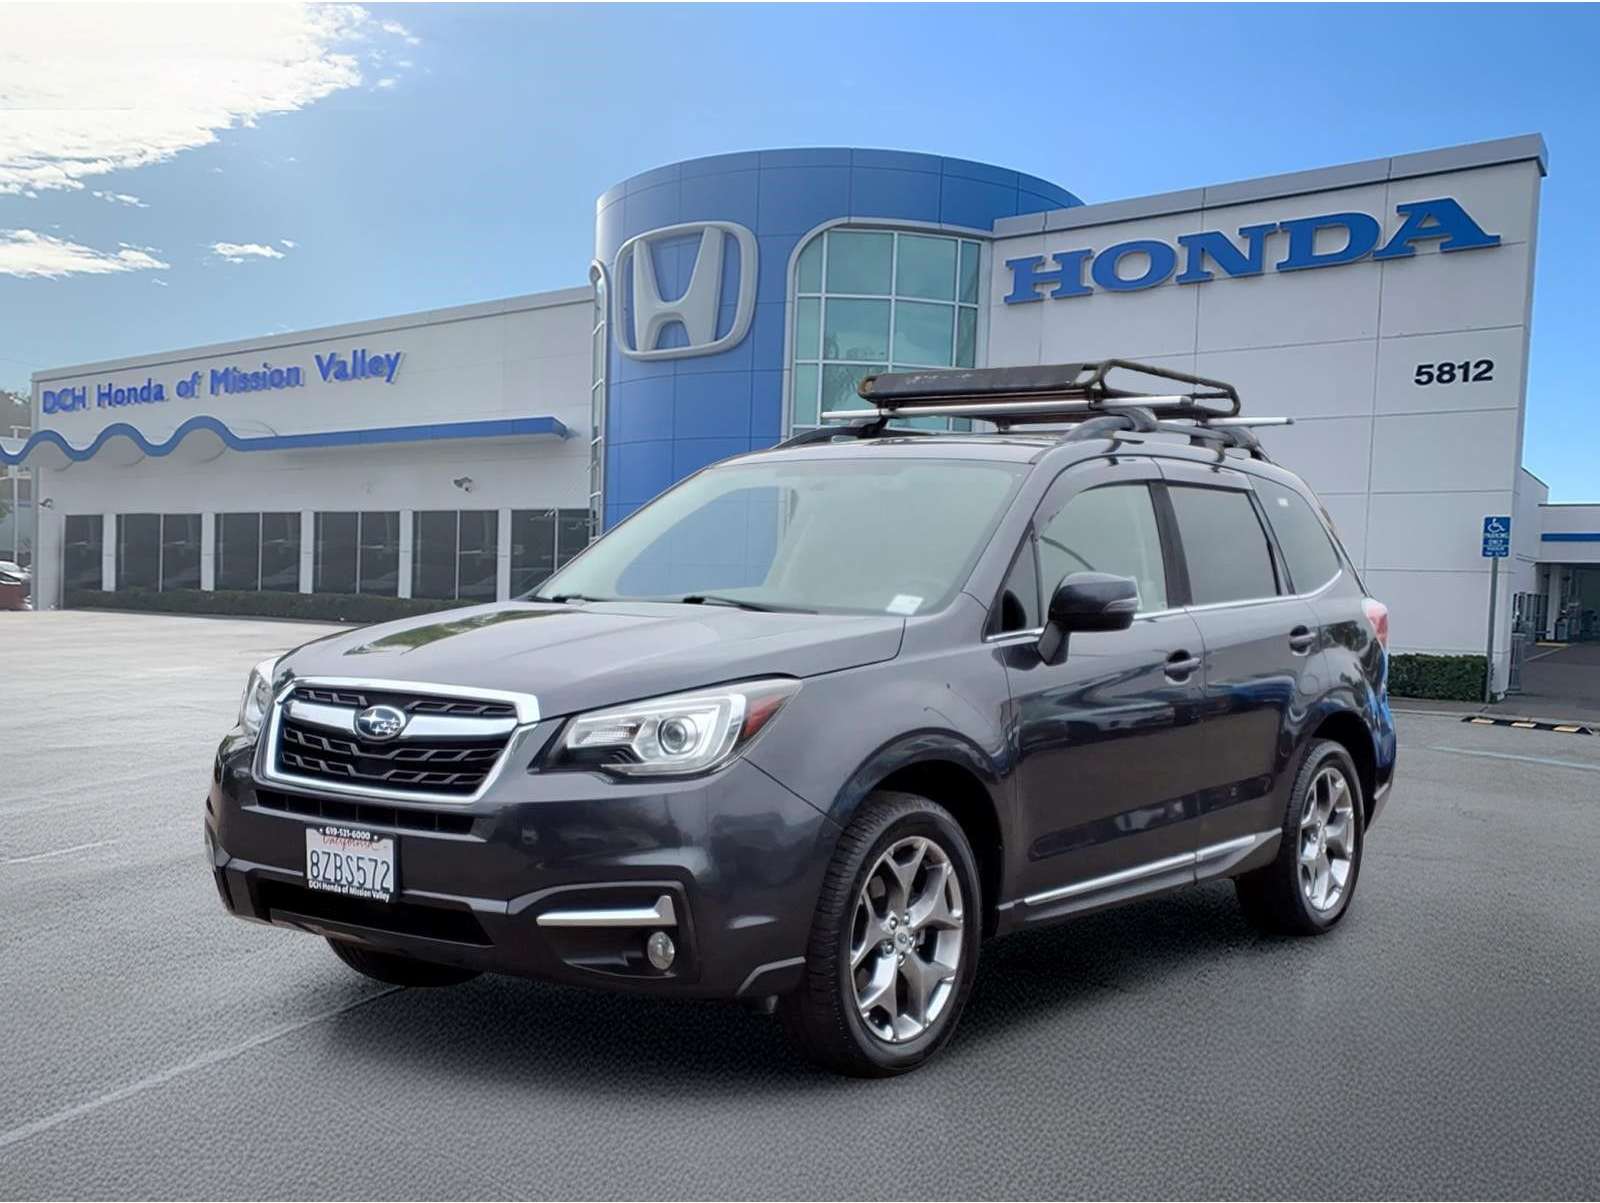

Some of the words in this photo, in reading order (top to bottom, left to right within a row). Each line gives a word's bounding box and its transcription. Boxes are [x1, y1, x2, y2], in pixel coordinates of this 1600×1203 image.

[1003, 196, 1502, 305] HONDA
[42, 386, 88, 415] DCH
[96, 377, 165, 408] Honda
[176, 370, 202, 399] of
[210, 362, 302, 396] Mission
[314, 348, 402, 384] Valley
[1413, 358, 1495, 386] 5812
[325, 826, 370, 840] 619-521-6000
[310, 849, 391, 892] 8ZBS572
[322, 881, 341, 893] Honda
[372, 889, 390, 903] Valley
